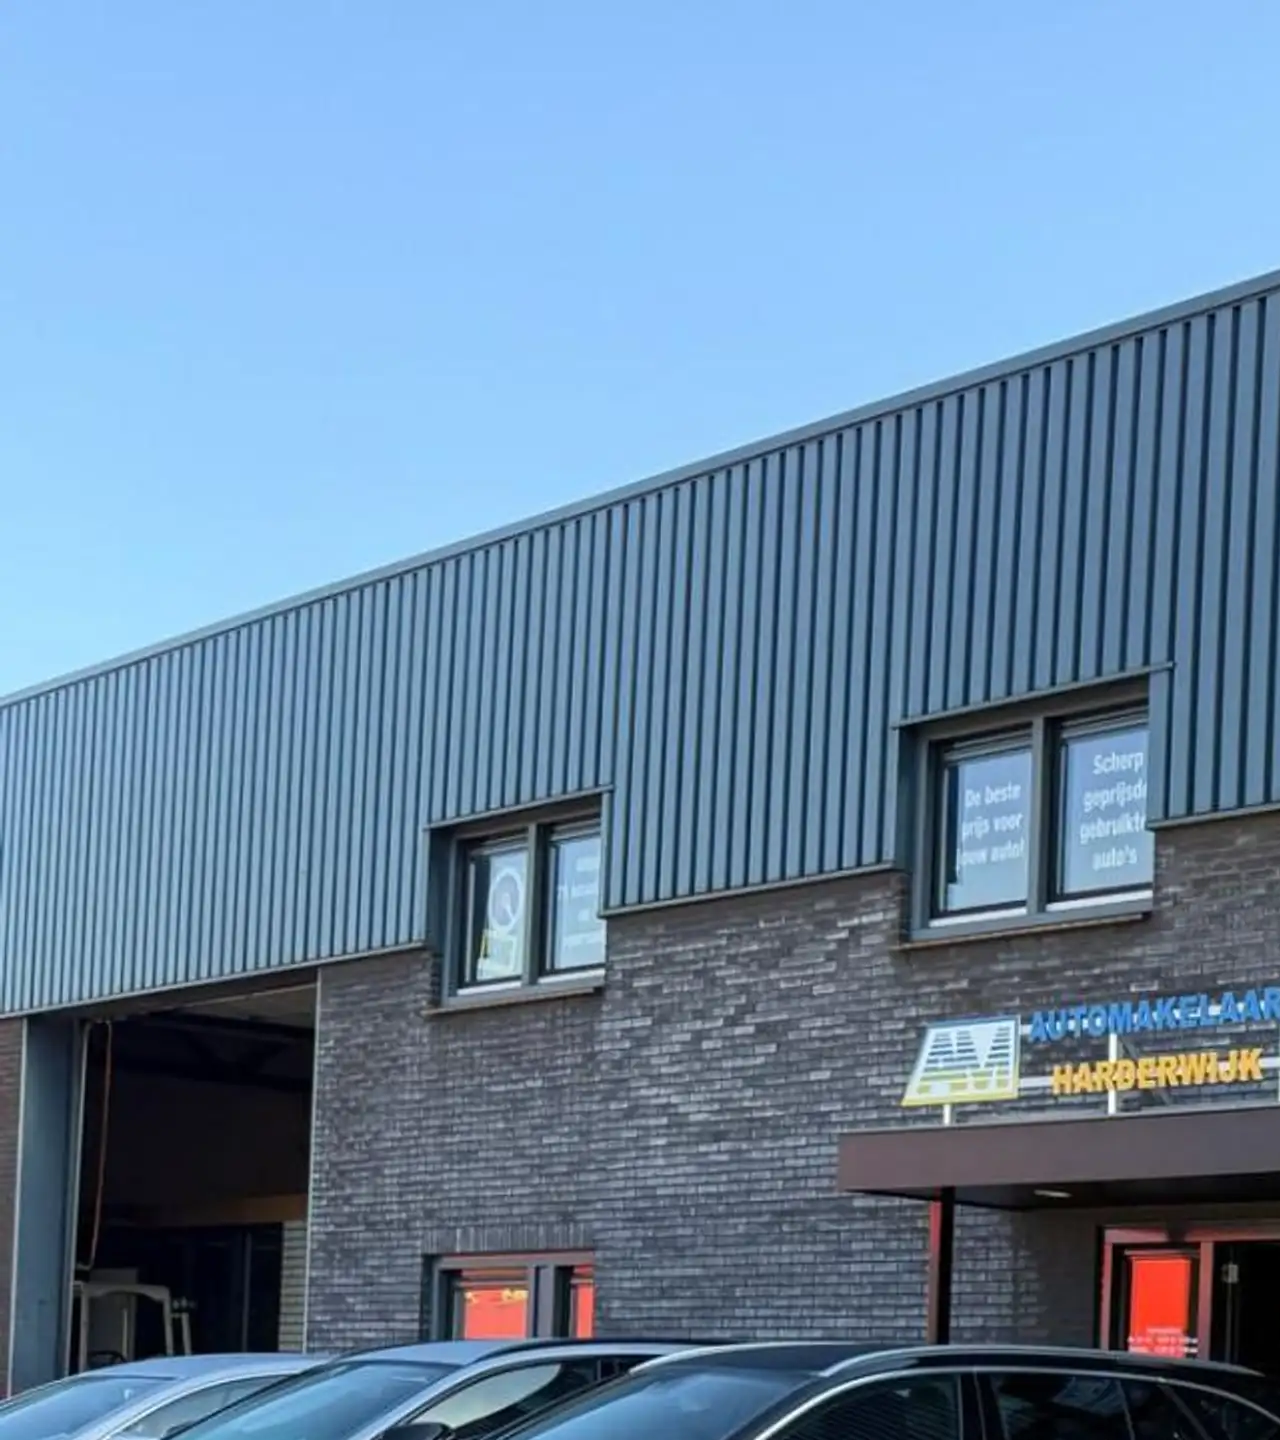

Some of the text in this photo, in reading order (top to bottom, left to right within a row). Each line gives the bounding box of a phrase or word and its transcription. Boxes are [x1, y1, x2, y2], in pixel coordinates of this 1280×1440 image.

[1092, 751, 1144, 775] Scherp
[994, 812, 1023, 832] voor
[1052, 1048, 1264, 1095] HARDERWIJK
